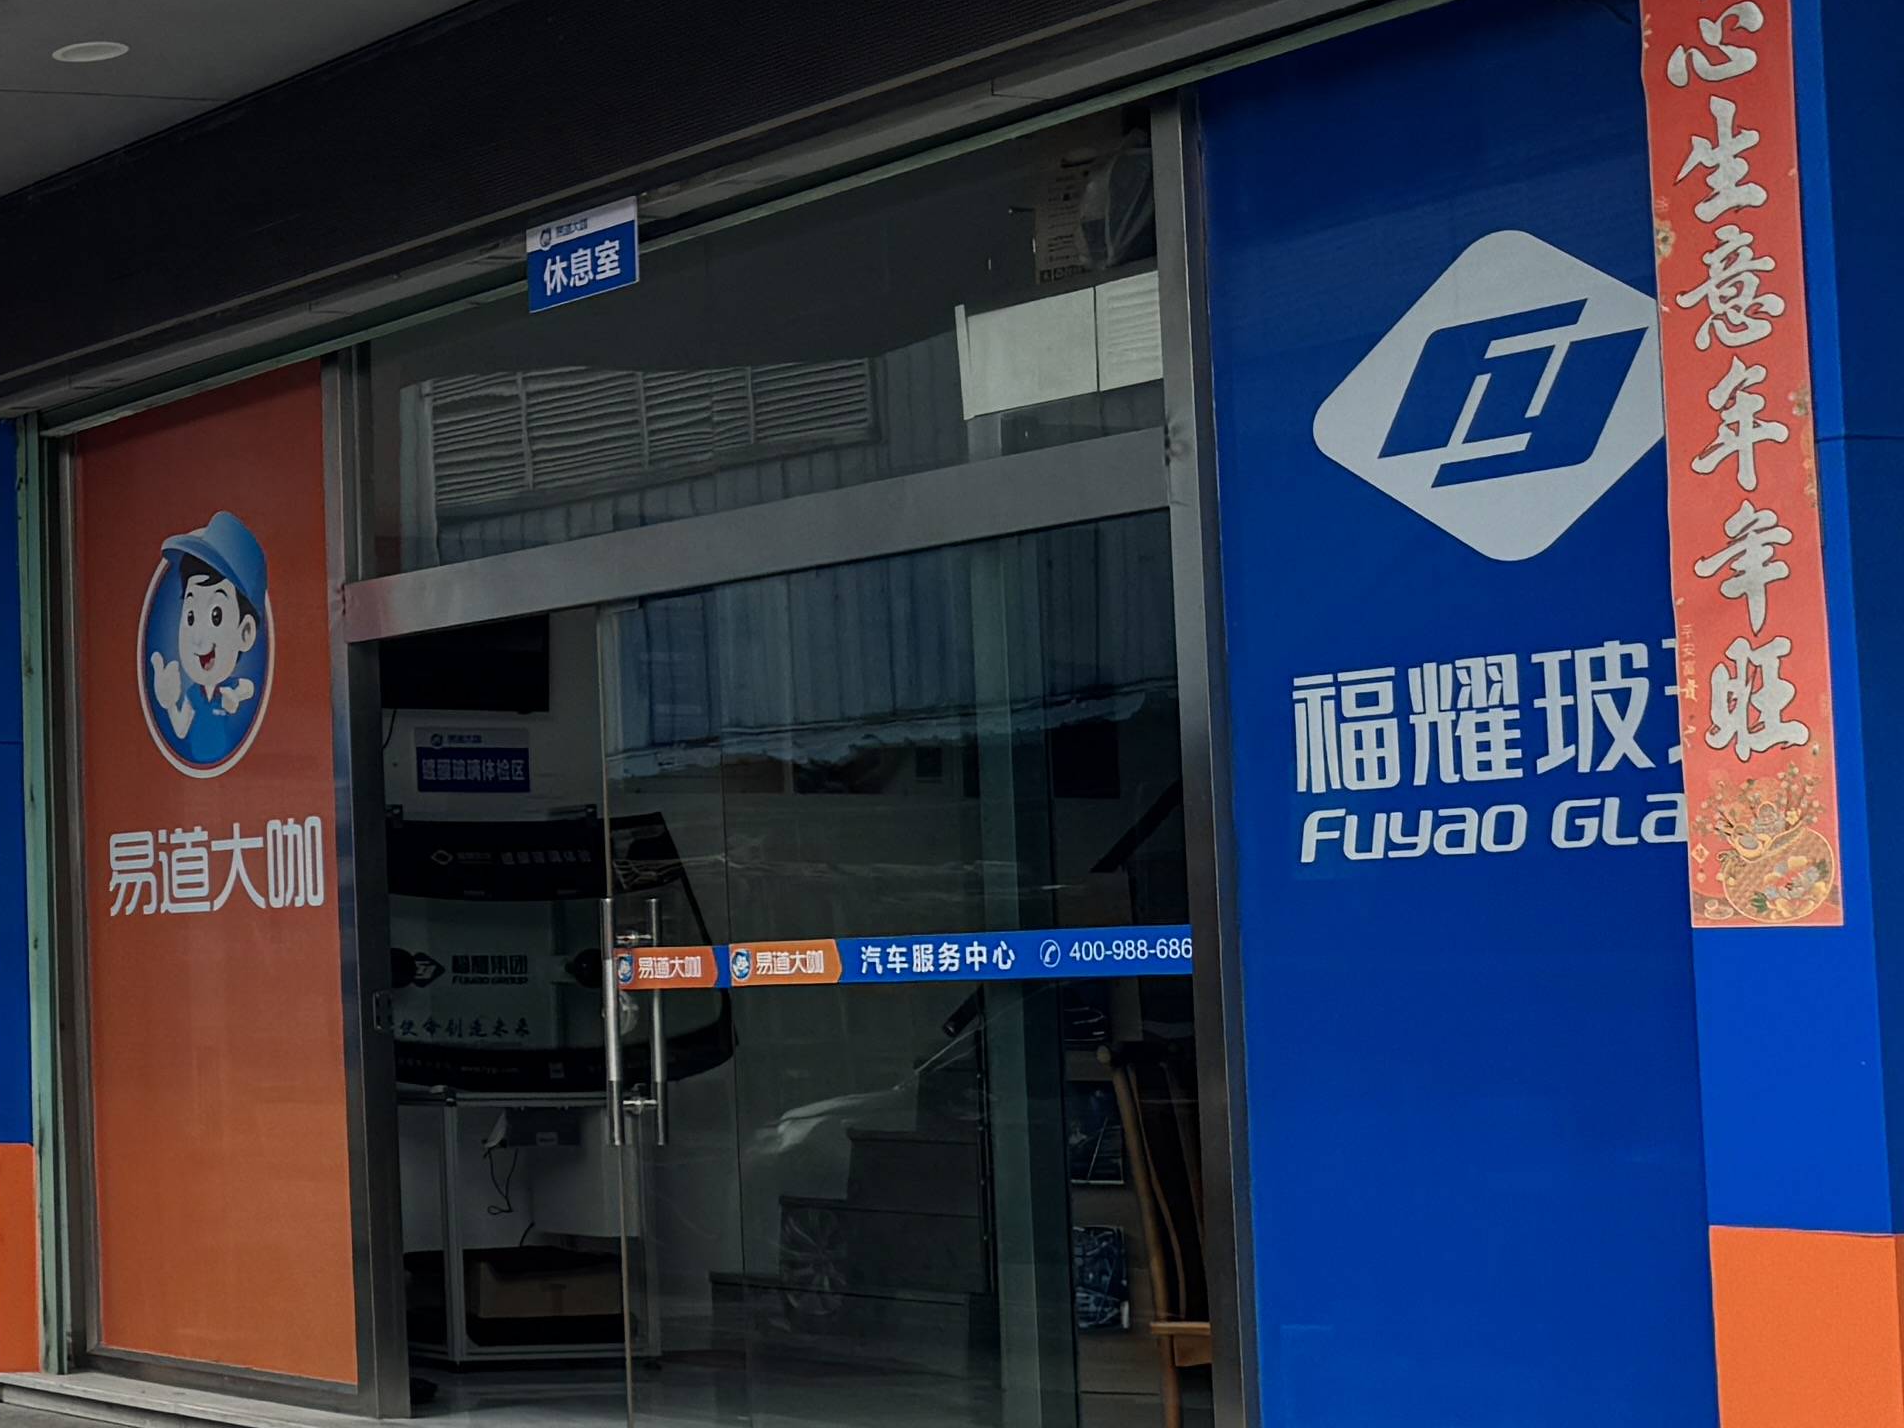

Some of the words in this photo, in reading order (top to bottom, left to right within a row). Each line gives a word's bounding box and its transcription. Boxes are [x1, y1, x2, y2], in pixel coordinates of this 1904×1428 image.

[543, 239, 621, 296] 休息室
[1292, 638, 1684, 794] 福耀玻
[109, 815, 325, 917] 易道大咖
[638, 955, 702, 979] 易道大咖
[755, 950, 825, 975] 易道大咖
[860, 941, 1016, 974] 汽车服务中心
